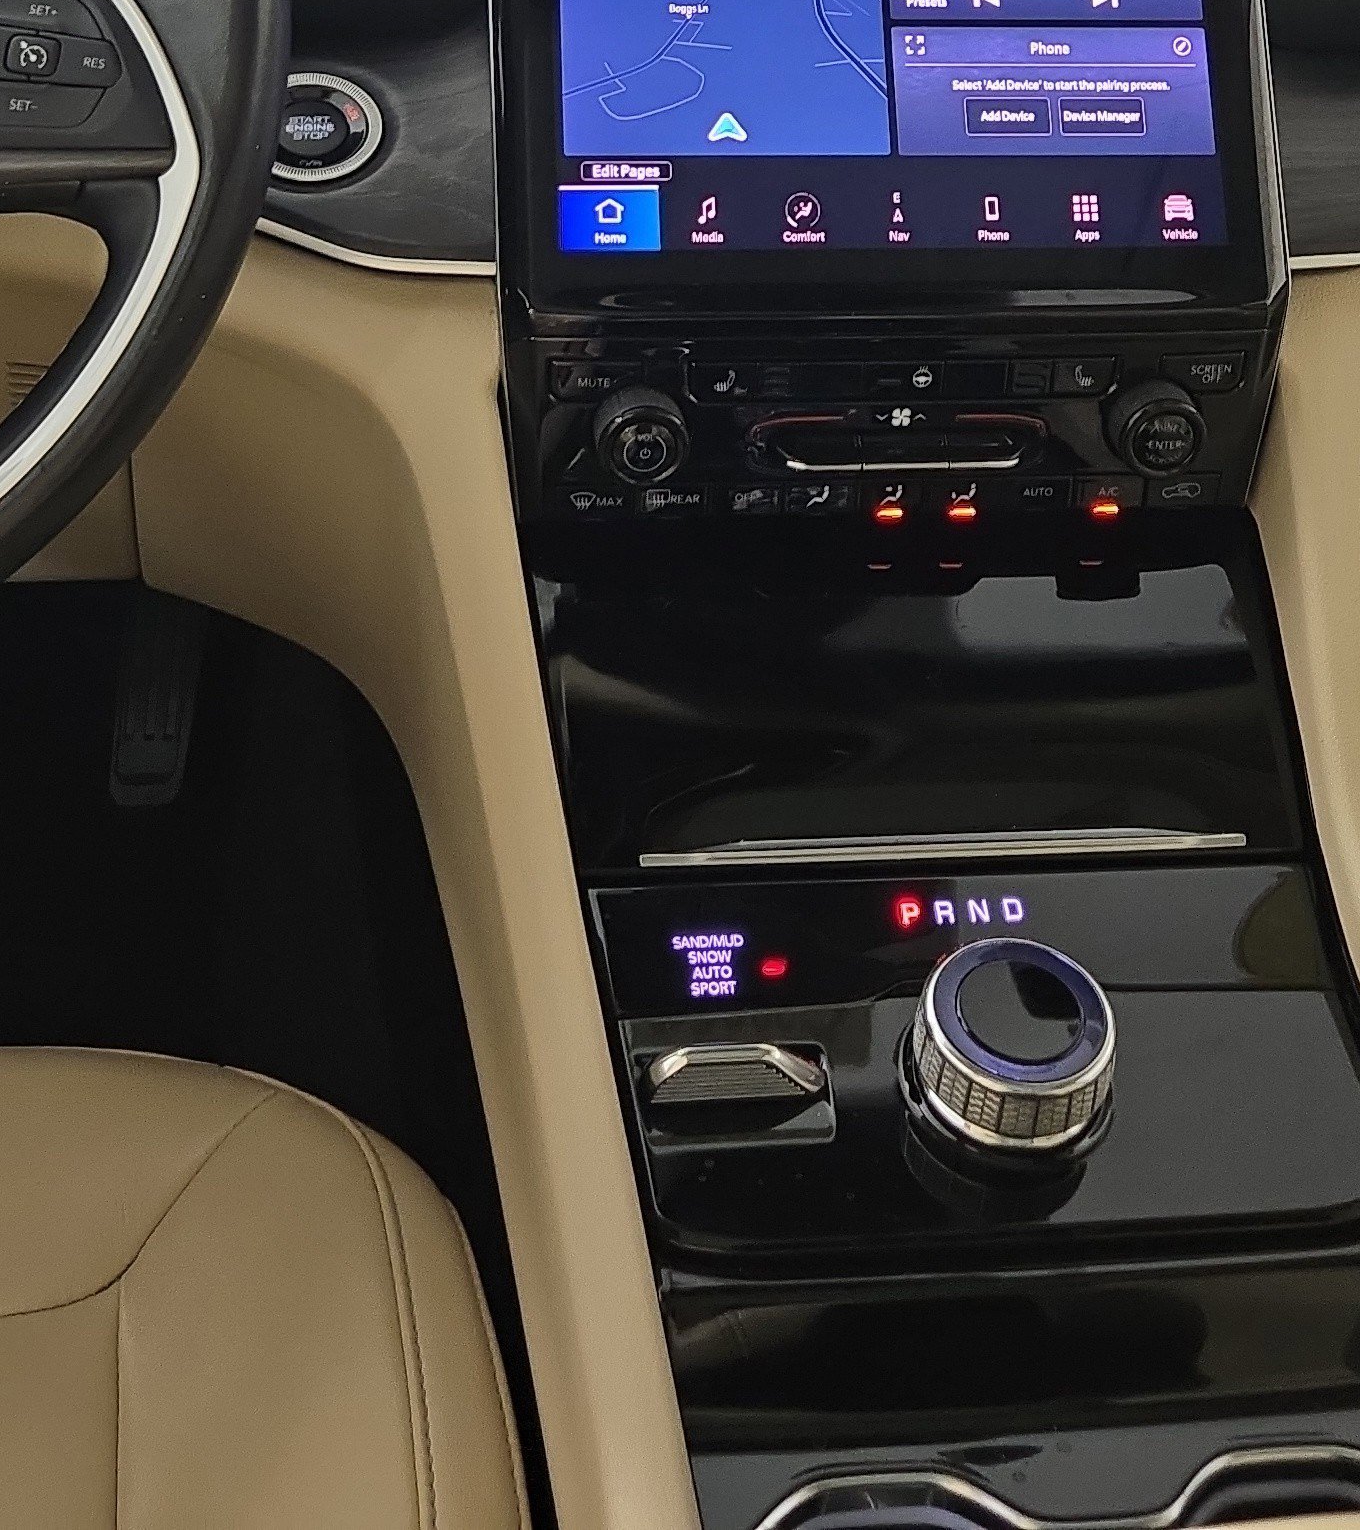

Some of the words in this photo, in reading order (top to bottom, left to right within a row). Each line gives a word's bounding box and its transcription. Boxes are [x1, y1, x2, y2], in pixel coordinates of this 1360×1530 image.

[1030, 41, 1071, 56] Phone
[82, 56, 106, 69] RES
[952, 80, 983, 92] Select
[1043, 81, 1054, 91] to
[1055, 80, 1078, 92] start
[1078, 80, 1096, 91] the
[1096, 80, 1130, 93] pairing
[289, 115, 331, 125] START
[981, 110, 1002, 122] Add
[1002, 111, 1036, 122] Device
[1063, 110, 1097, 122] Device
[1097, 111, 1141, 124] Manager
[285, 122, 336, 134] ENGINE
[293, 130, 329, 141] STOP
[592, 164, 620, 178] Edit
[620, 165, 661, 180] Pages
[594, 232, 627, 245] Home
[691, 231, 724, 243] Media
[782, 231, 826, 244] Comfort
[888, 230, 910, 242] Nav
[977, 229, 1010, 242] Phone
[1075, 229, 1101, 243] Apps
[1162, 229, 1199, 241] Vehicle
[1190, 363, 1233, 376] SCREEN
[577, 377, 611, 388] MUTE
[1201, 373, 1222, 384] OFF
[637, 433, 655, 442] VOL
[1147, 439, 1182, 450] ENTER
[1023, 486, 1054, 497] AUTO
[1097, 486, 1120, 497] A/C
[596, 496, 623, 507] MAX
[670, 493, 700, 505] REAR
[900, 902, 920, 926] P
[933, 900, 956, 926] R
[967, 898, 991, 924] N
[1001, 898, 1023, 923] D
[672, 933, 744, 950] SAND/MUD
[687, 949, 732, 965] SNOW
[692, 964, 733, 980] AUTO
[690, 980, 737, 997] SPORT
